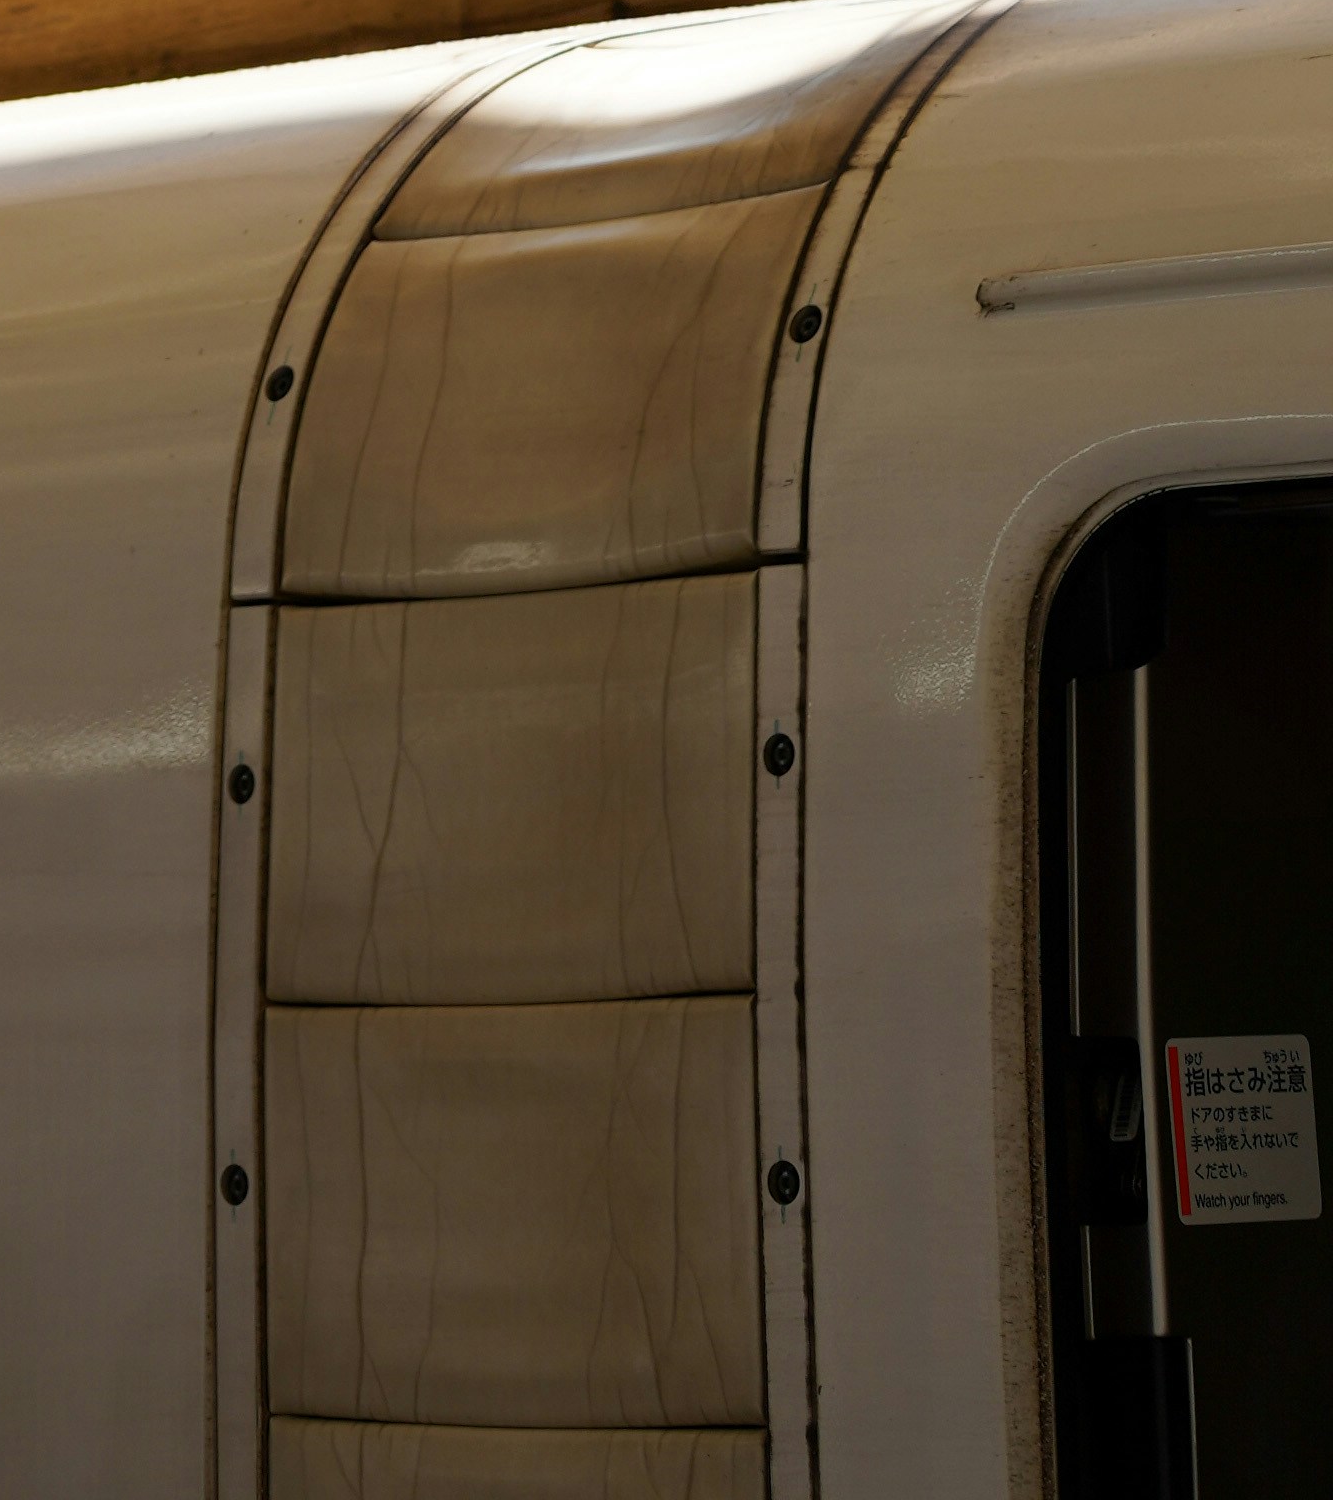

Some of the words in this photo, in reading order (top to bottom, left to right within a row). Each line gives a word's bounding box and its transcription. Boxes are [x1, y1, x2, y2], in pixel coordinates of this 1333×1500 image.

[1184, 1064, 1308, 1097] 指はさみ注意
[1191, 1105, 1273, 1124] ドアのすきまに
[1191, 1131, 1299, 1152] 手や指を入れないで
[1194, 1163, 1248, 1180] ください。
[1194, 1192, 1226, 1209] Watch
[1228, 1193, 1251, 1210] your
[1253, 1191, 1288, 1209] fingers.
